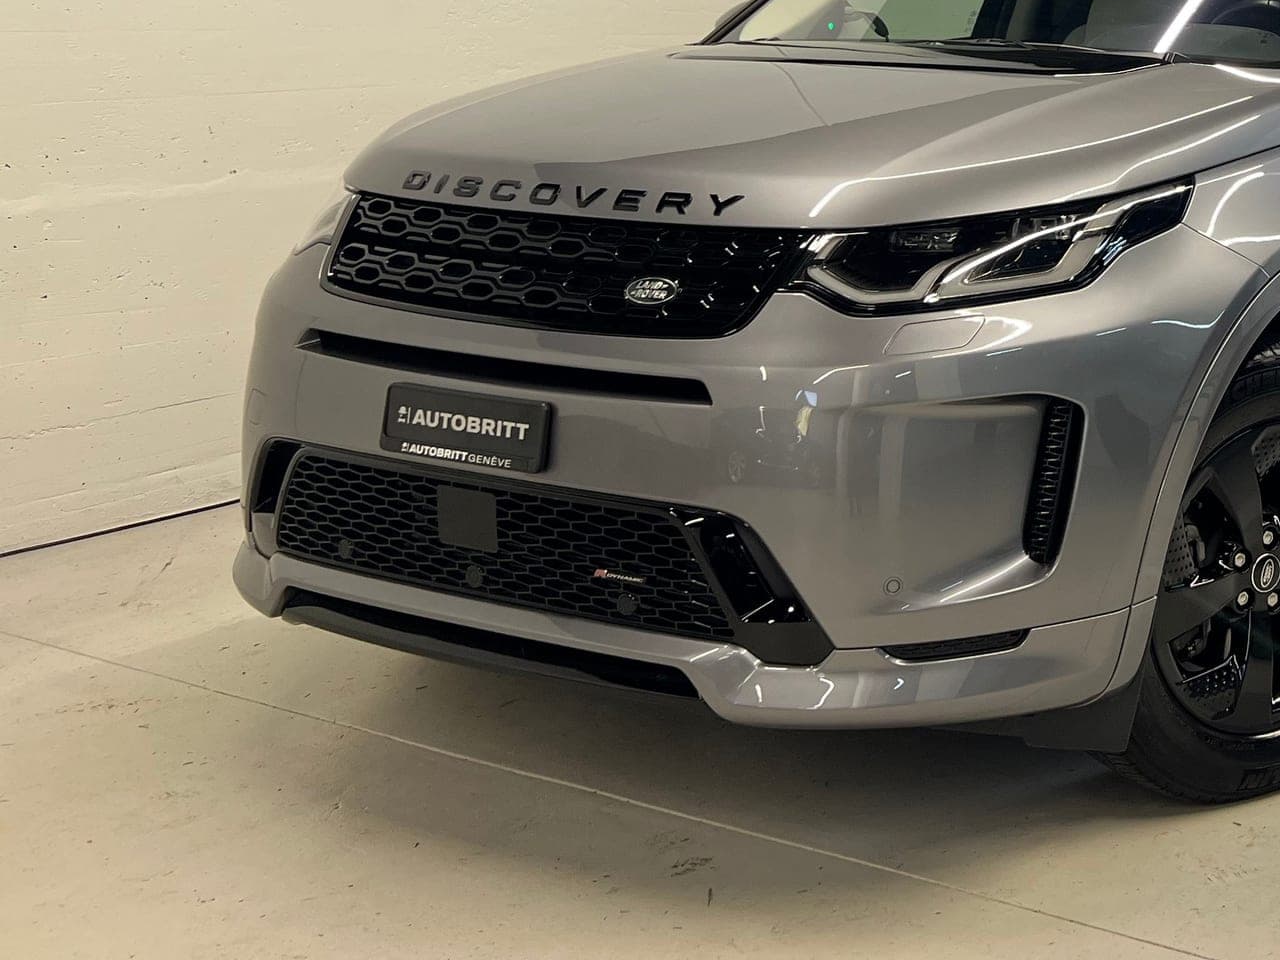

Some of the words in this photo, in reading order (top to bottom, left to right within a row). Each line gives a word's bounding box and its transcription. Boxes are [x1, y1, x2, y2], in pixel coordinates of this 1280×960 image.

[402, 170, 746, 216] DISCOVERY
[412, 409, 530, 441] AUTOBRITT
[408, 443, 468, 462] AUTOBRITT
[468, 452, 512, 468] GENÈVE
